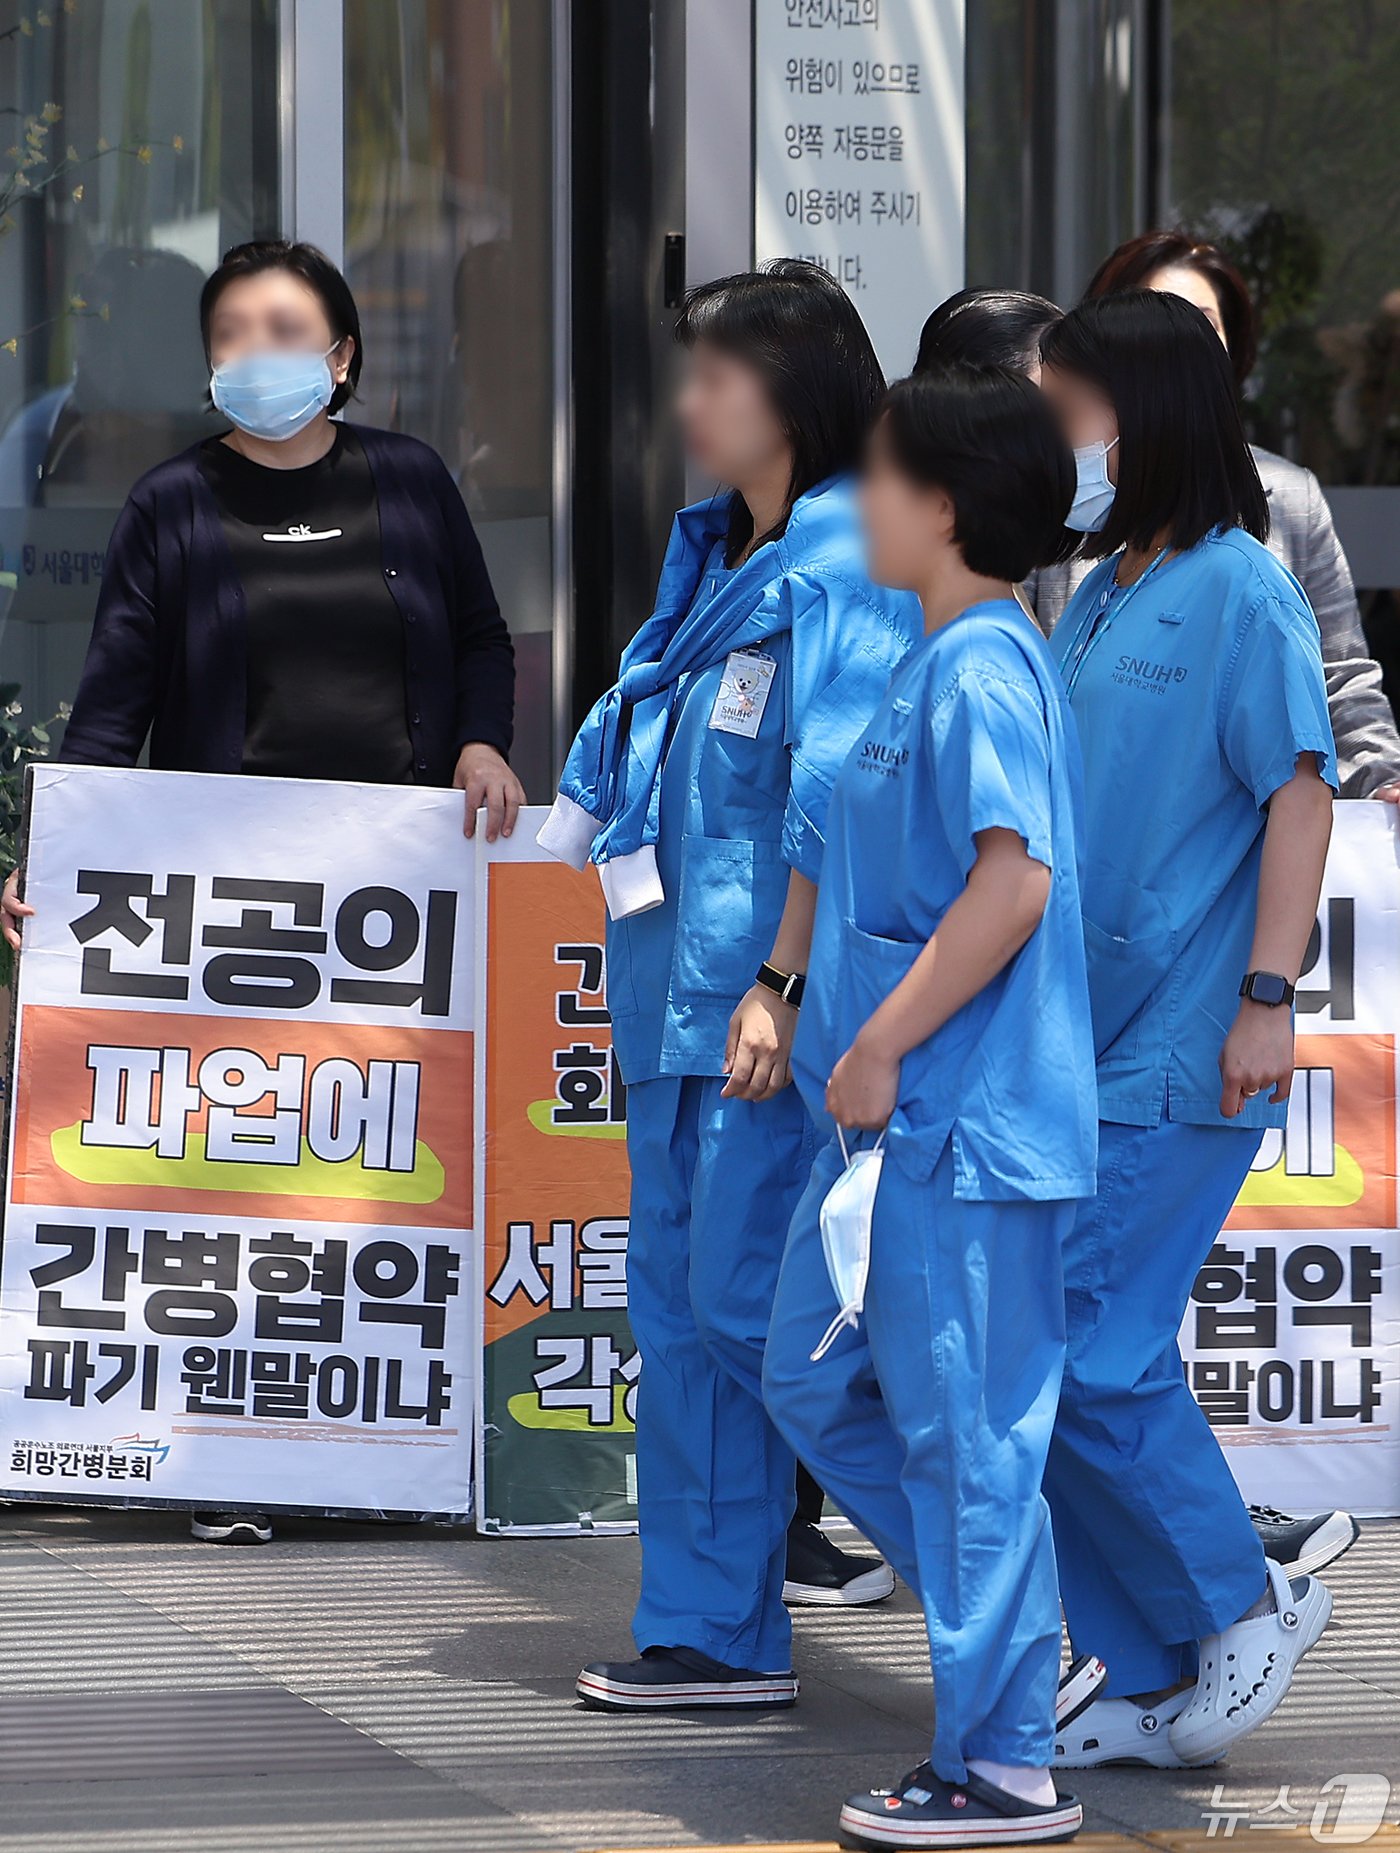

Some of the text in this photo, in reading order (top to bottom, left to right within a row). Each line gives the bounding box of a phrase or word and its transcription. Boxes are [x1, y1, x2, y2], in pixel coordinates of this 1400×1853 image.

[785, 58, 920, 95] 위험이 있으므로
[785, 124, 903, 161] 양쪽 자동문을
[786, 189, 920, 226] 이용하여 주시기
[1115, 656, 1173, 684] SNUH
[861, 741, 900, 767] SNUH
[69, 870, 459, 1017] 전공의
[80, 1043, 421, 1173] 파업에
[29, 1225, 461, 1349] 간병협약
[23, 1339, 452, 1427] 파기 웬말이냐
[10, 1449, 153, 1482] 희망간병분회
